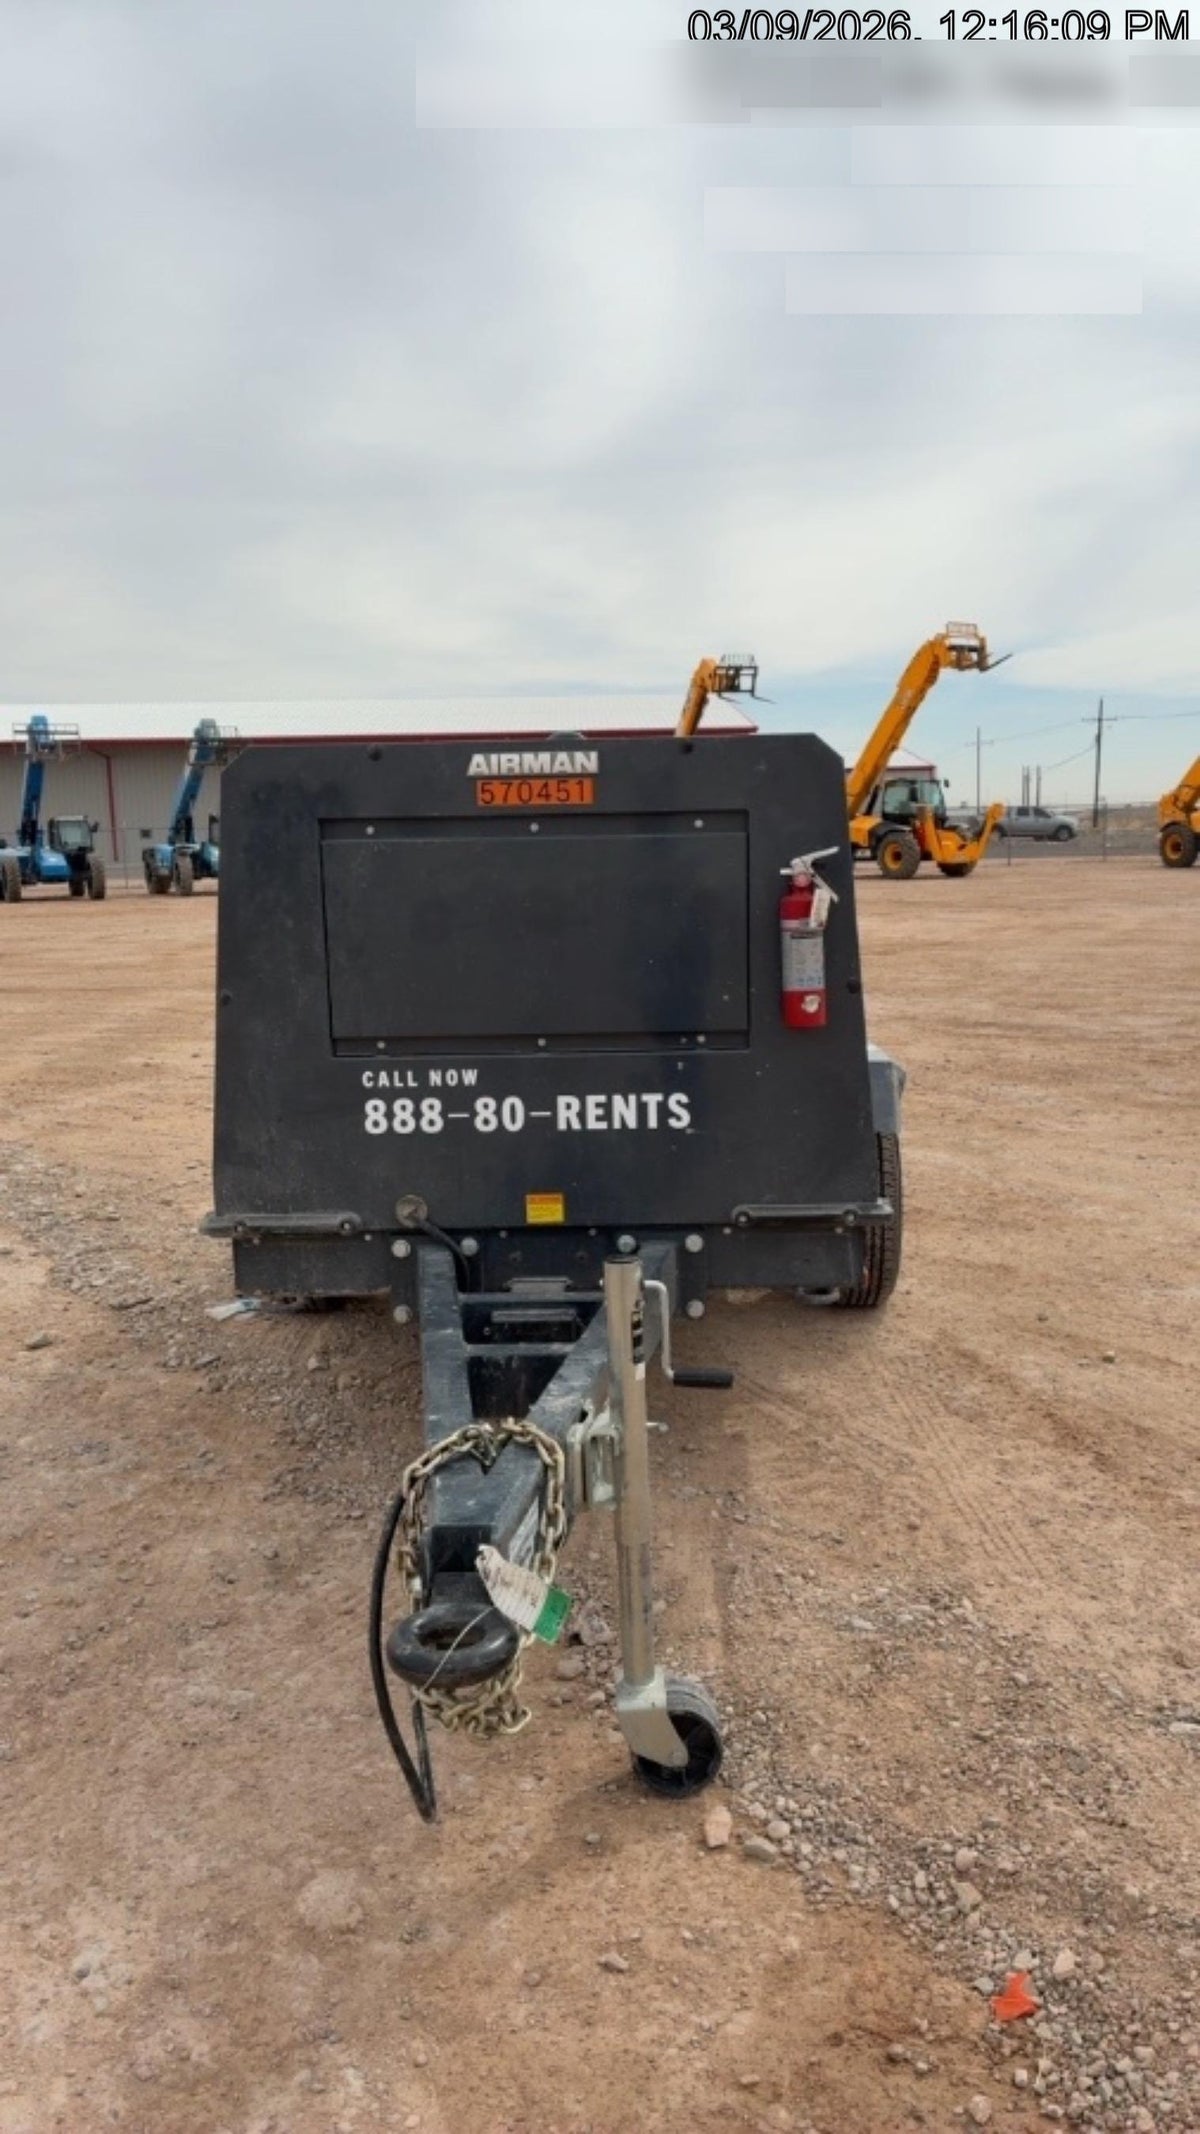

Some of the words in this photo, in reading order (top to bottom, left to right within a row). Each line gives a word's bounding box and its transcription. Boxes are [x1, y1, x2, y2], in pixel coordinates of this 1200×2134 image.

[467, 751, 599, 776] AIRMAN
[480, 779, 585, 805] 570451
[362, 1070, 419, 1088] CALL
[429, 1068, 479, 1087] NOW
[364, 1092, 691, 1134] 888-80-RENTS
